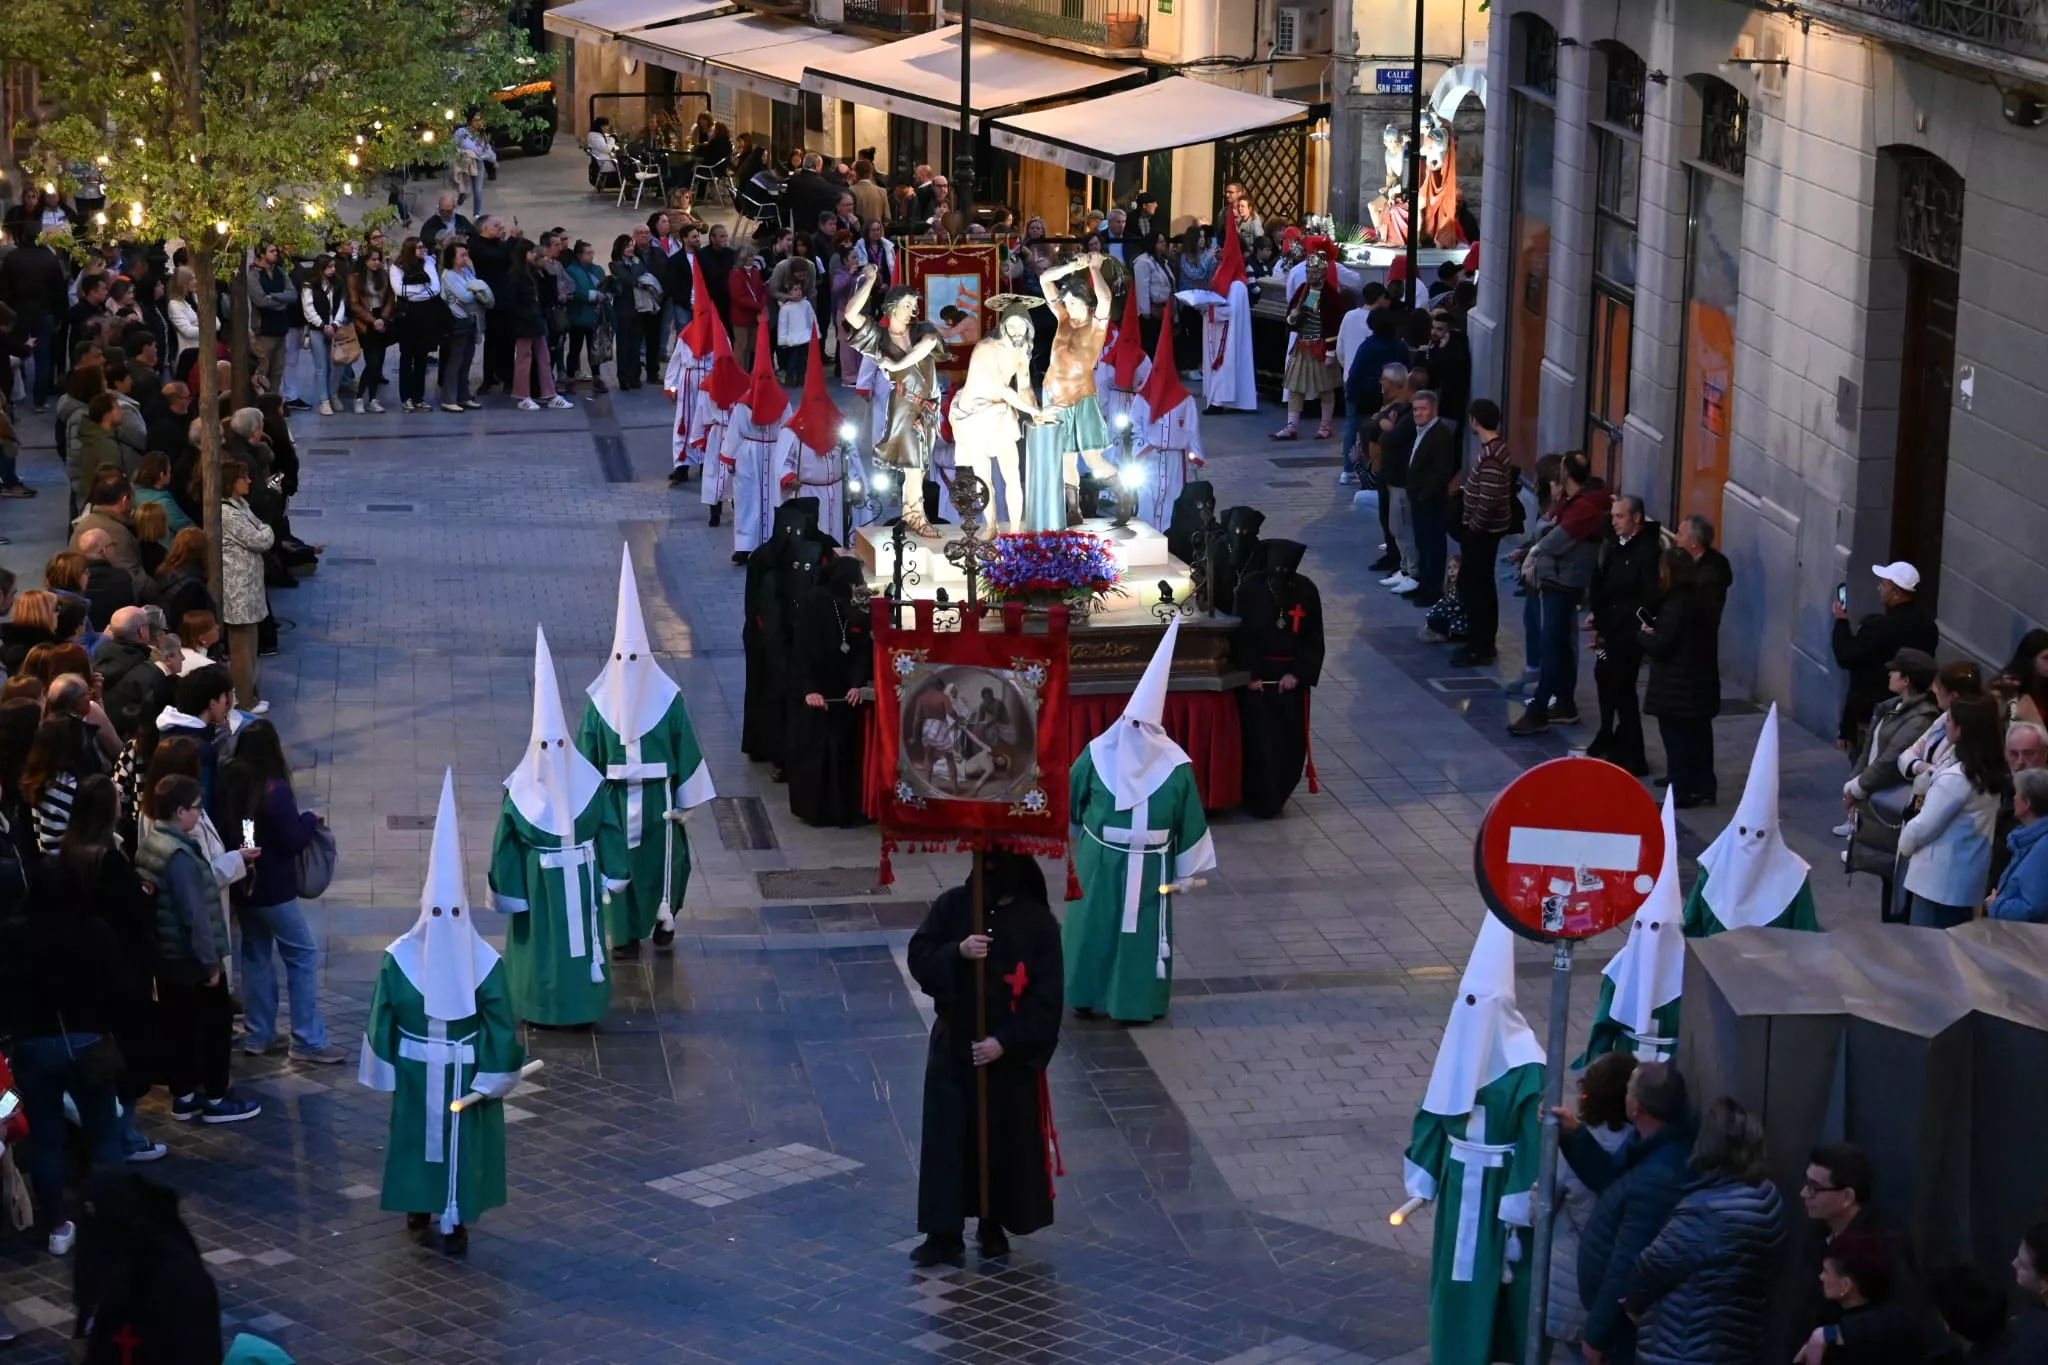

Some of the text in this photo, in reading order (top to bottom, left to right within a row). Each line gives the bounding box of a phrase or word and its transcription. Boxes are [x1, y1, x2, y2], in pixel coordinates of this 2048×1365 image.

[1387, 71, 1410, 79] CALLE
[1377, 84, 1413, 94] SAN ORENC
